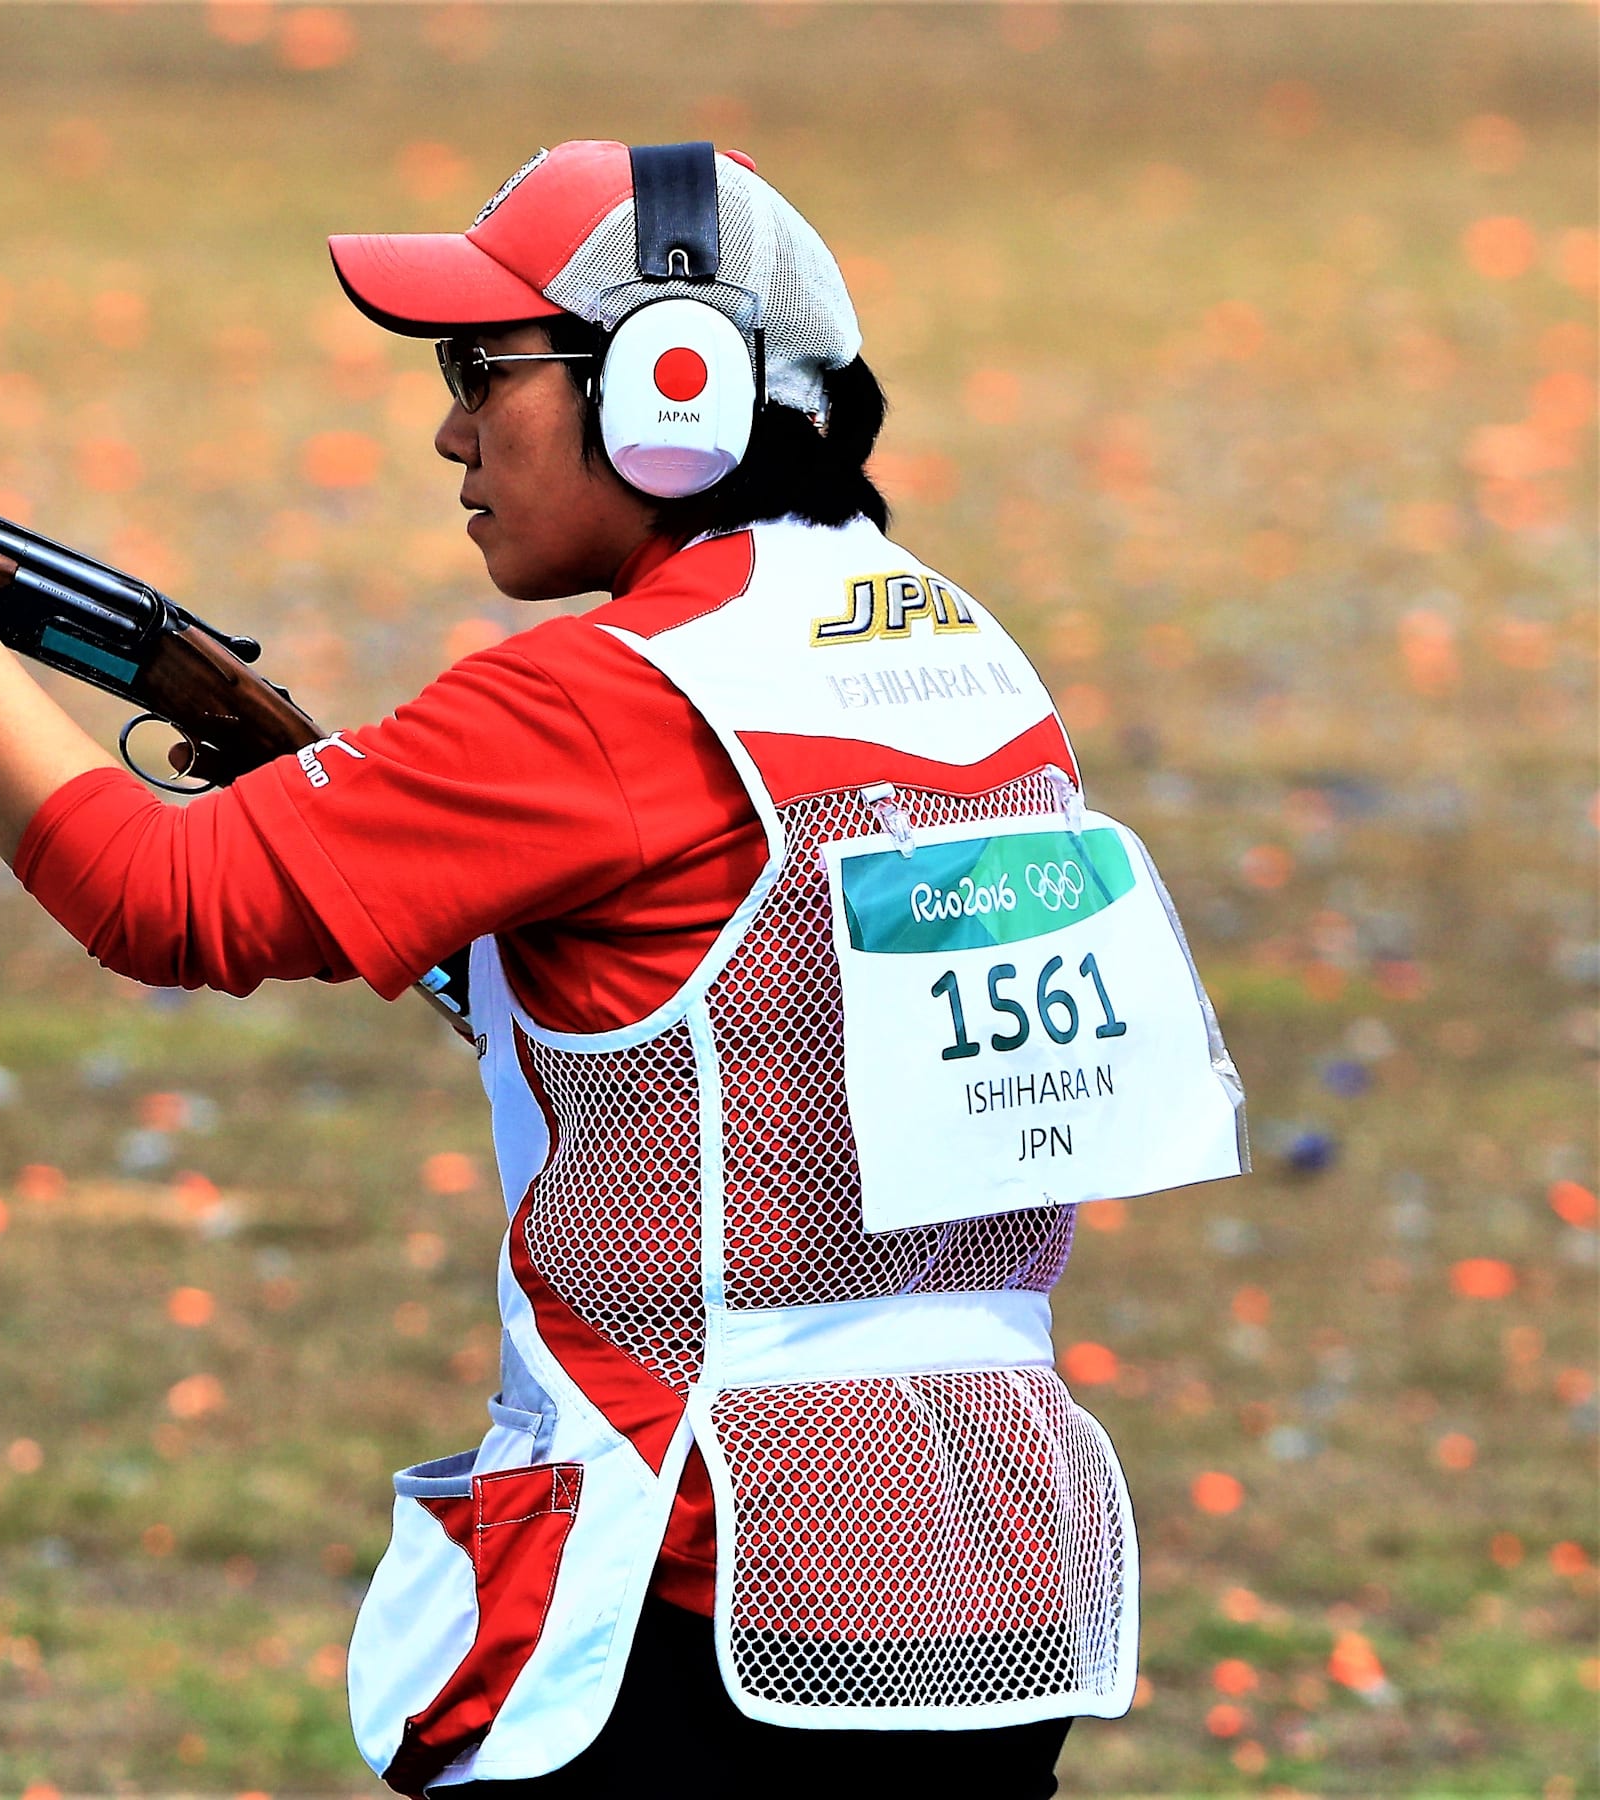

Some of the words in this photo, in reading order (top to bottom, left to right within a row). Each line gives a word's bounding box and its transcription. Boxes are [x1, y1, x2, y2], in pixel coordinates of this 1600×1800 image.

[657, 410, 700, 424] JAPAN
[810, 571, 980, 646] JPN
[826, 665, 987, 709] ISHIHARA
[987, 661, 1022, 695] N.
[910, 873, 1017, 924] Rio2016
[930, 952, 1127, 1061] 1561
[965, 1068, 1091, 1115] ISHIHARA
[1096, 1064, 1115, 1097] N
[1019, 1124, 1074, 1162] JPN
